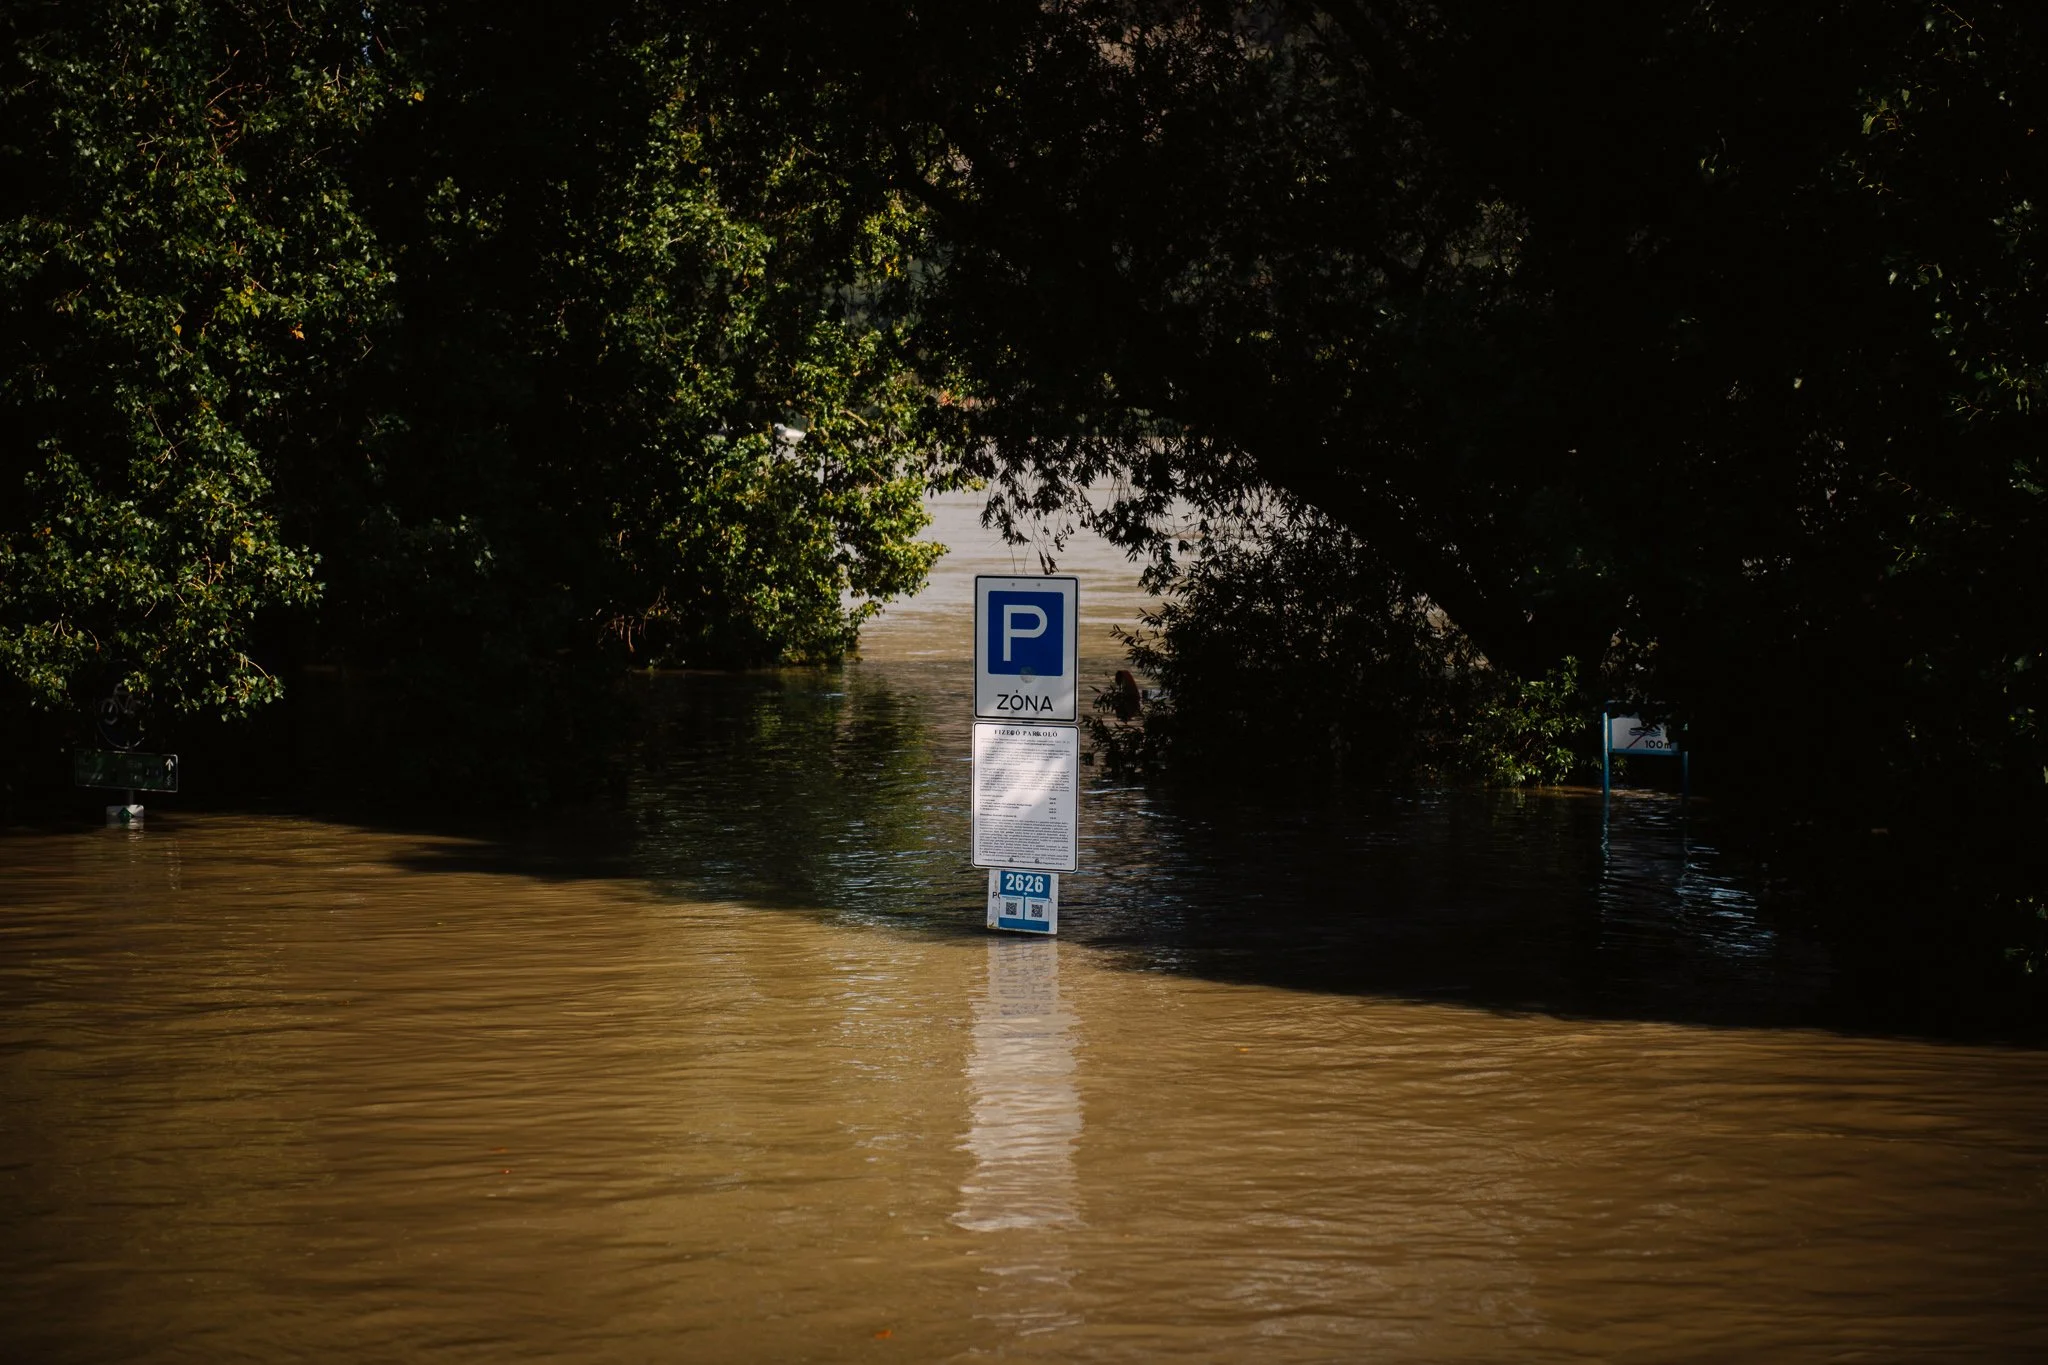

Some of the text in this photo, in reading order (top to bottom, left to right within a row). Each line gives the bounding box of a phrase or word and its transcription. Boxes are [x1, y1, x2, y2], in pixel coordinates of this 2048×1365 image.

[1003, 604, 1048, 661] P
[997, 690, 1053, 712] ZÓNA
[1005, 873, 1044, 893] 2626
